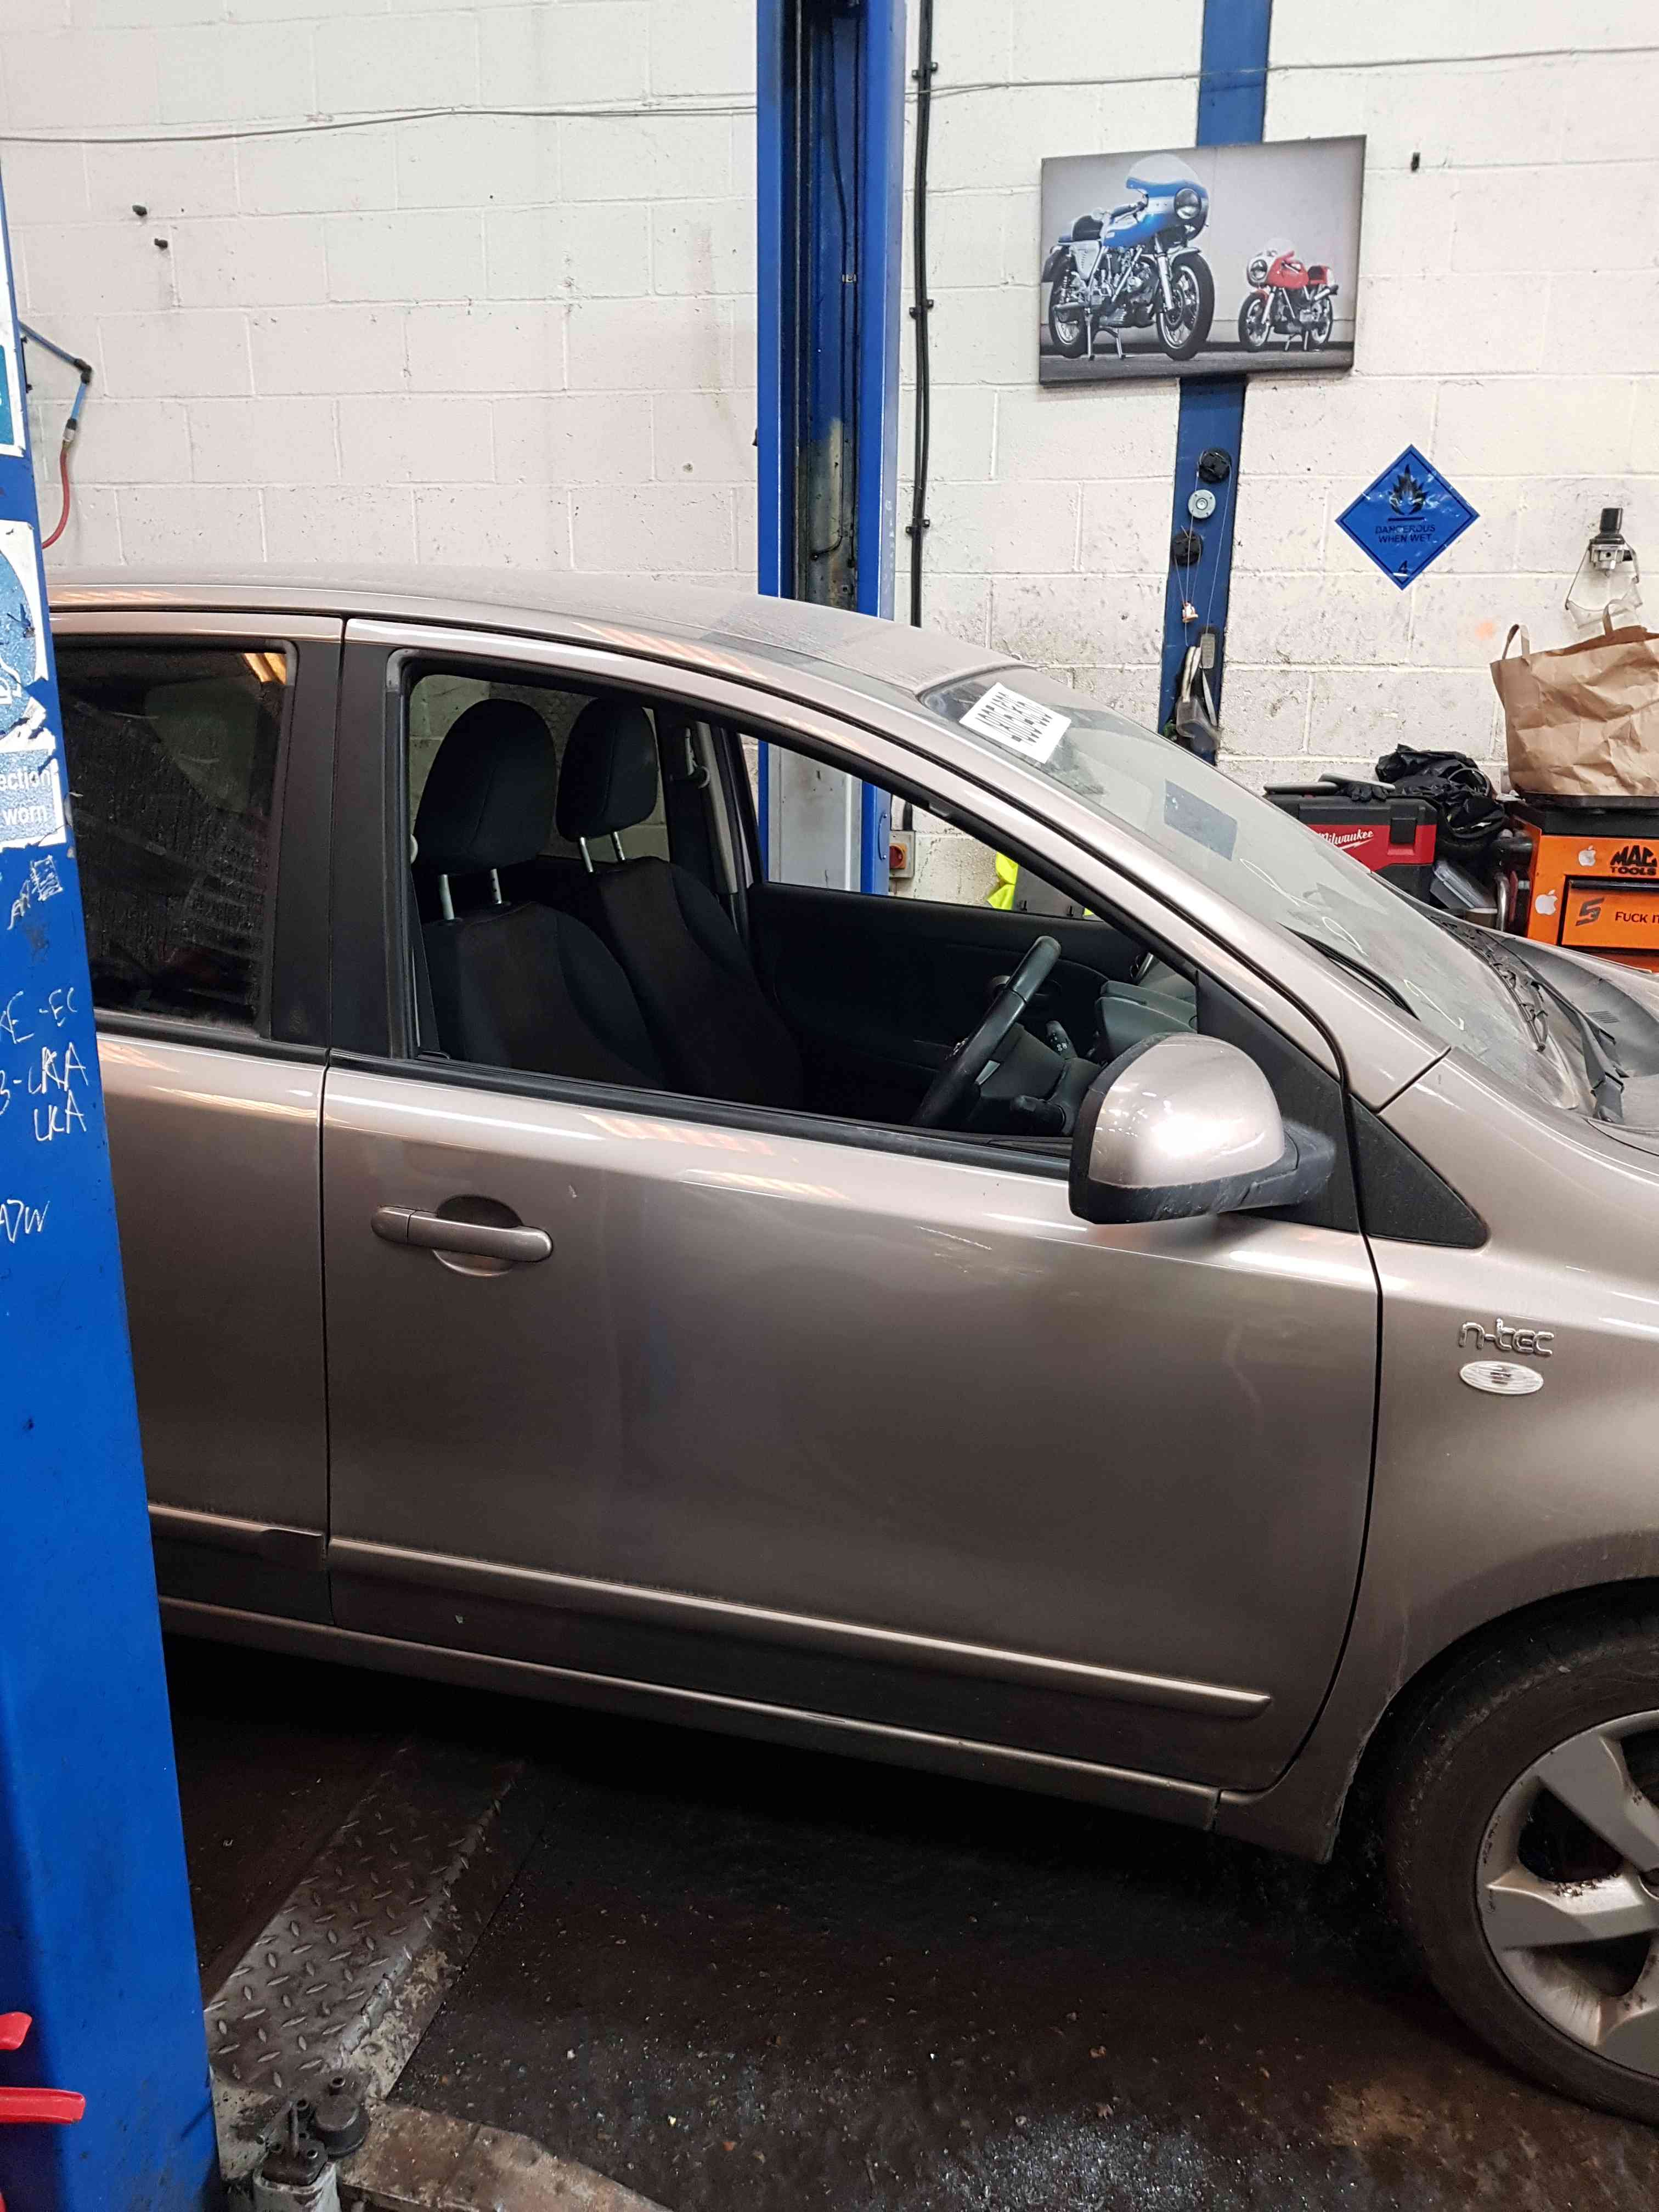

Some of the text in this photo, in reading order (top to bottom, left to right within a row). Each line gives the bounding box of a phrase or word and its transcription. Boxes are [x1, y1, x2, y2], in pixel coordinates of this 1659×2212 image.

[1375, 524, 1436, 534] DANGEROUS
[1398, 560, 1408, 573] 4
[3, 804, 47, 826] worn
[1610, 845, 1657, 867] MAC
[1611, 866, 1656, 876] TOOLS
[1615, 911, 1648, 923] FUCK
[1458, 1318, 1554, 1357] n-tec
